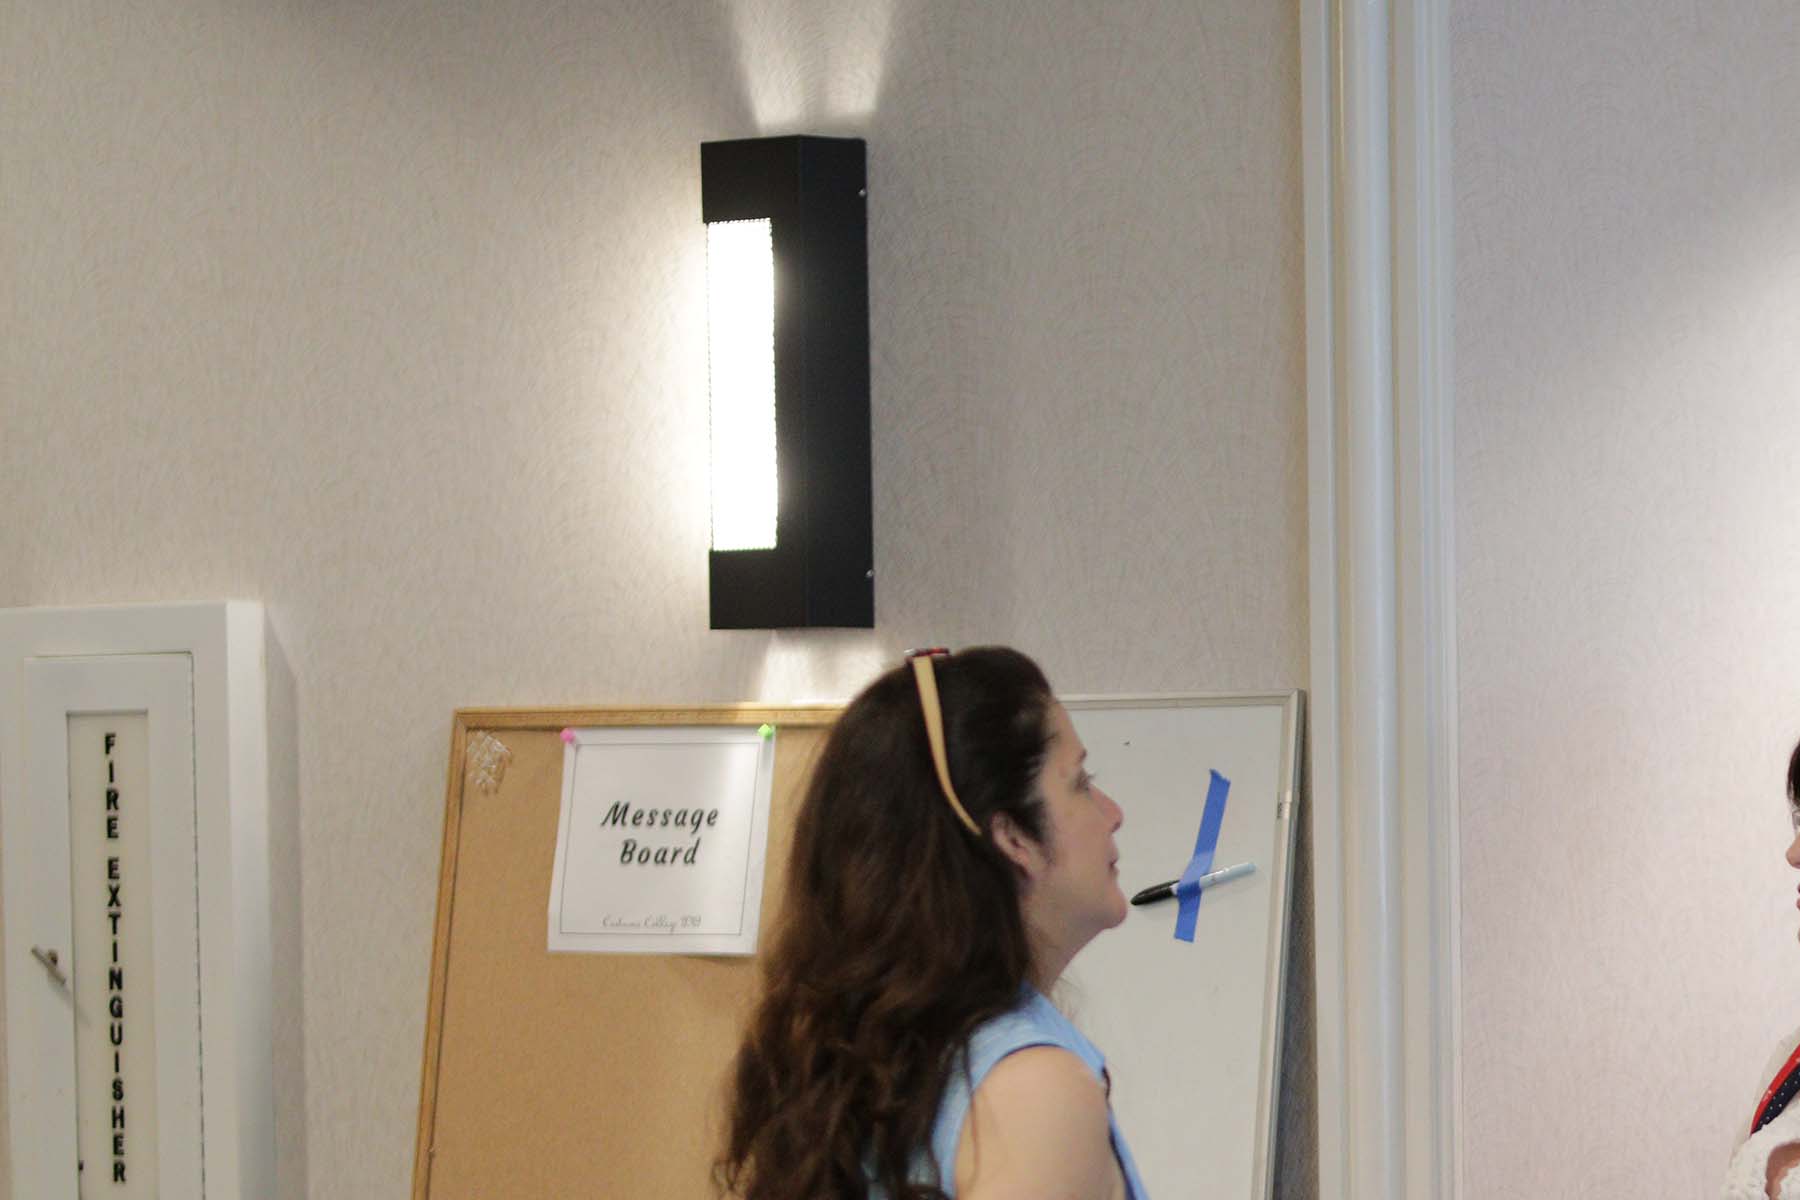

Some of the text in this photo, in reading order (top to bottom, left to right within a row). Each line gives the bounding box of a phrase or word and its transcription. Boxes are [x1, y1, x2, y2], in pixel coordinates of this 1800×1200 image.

[601, 800, 719, 834] Message
[620, 838, 701, 866] Board
[104, 732, 127, 1184] FIRE EXTINGUISHER
